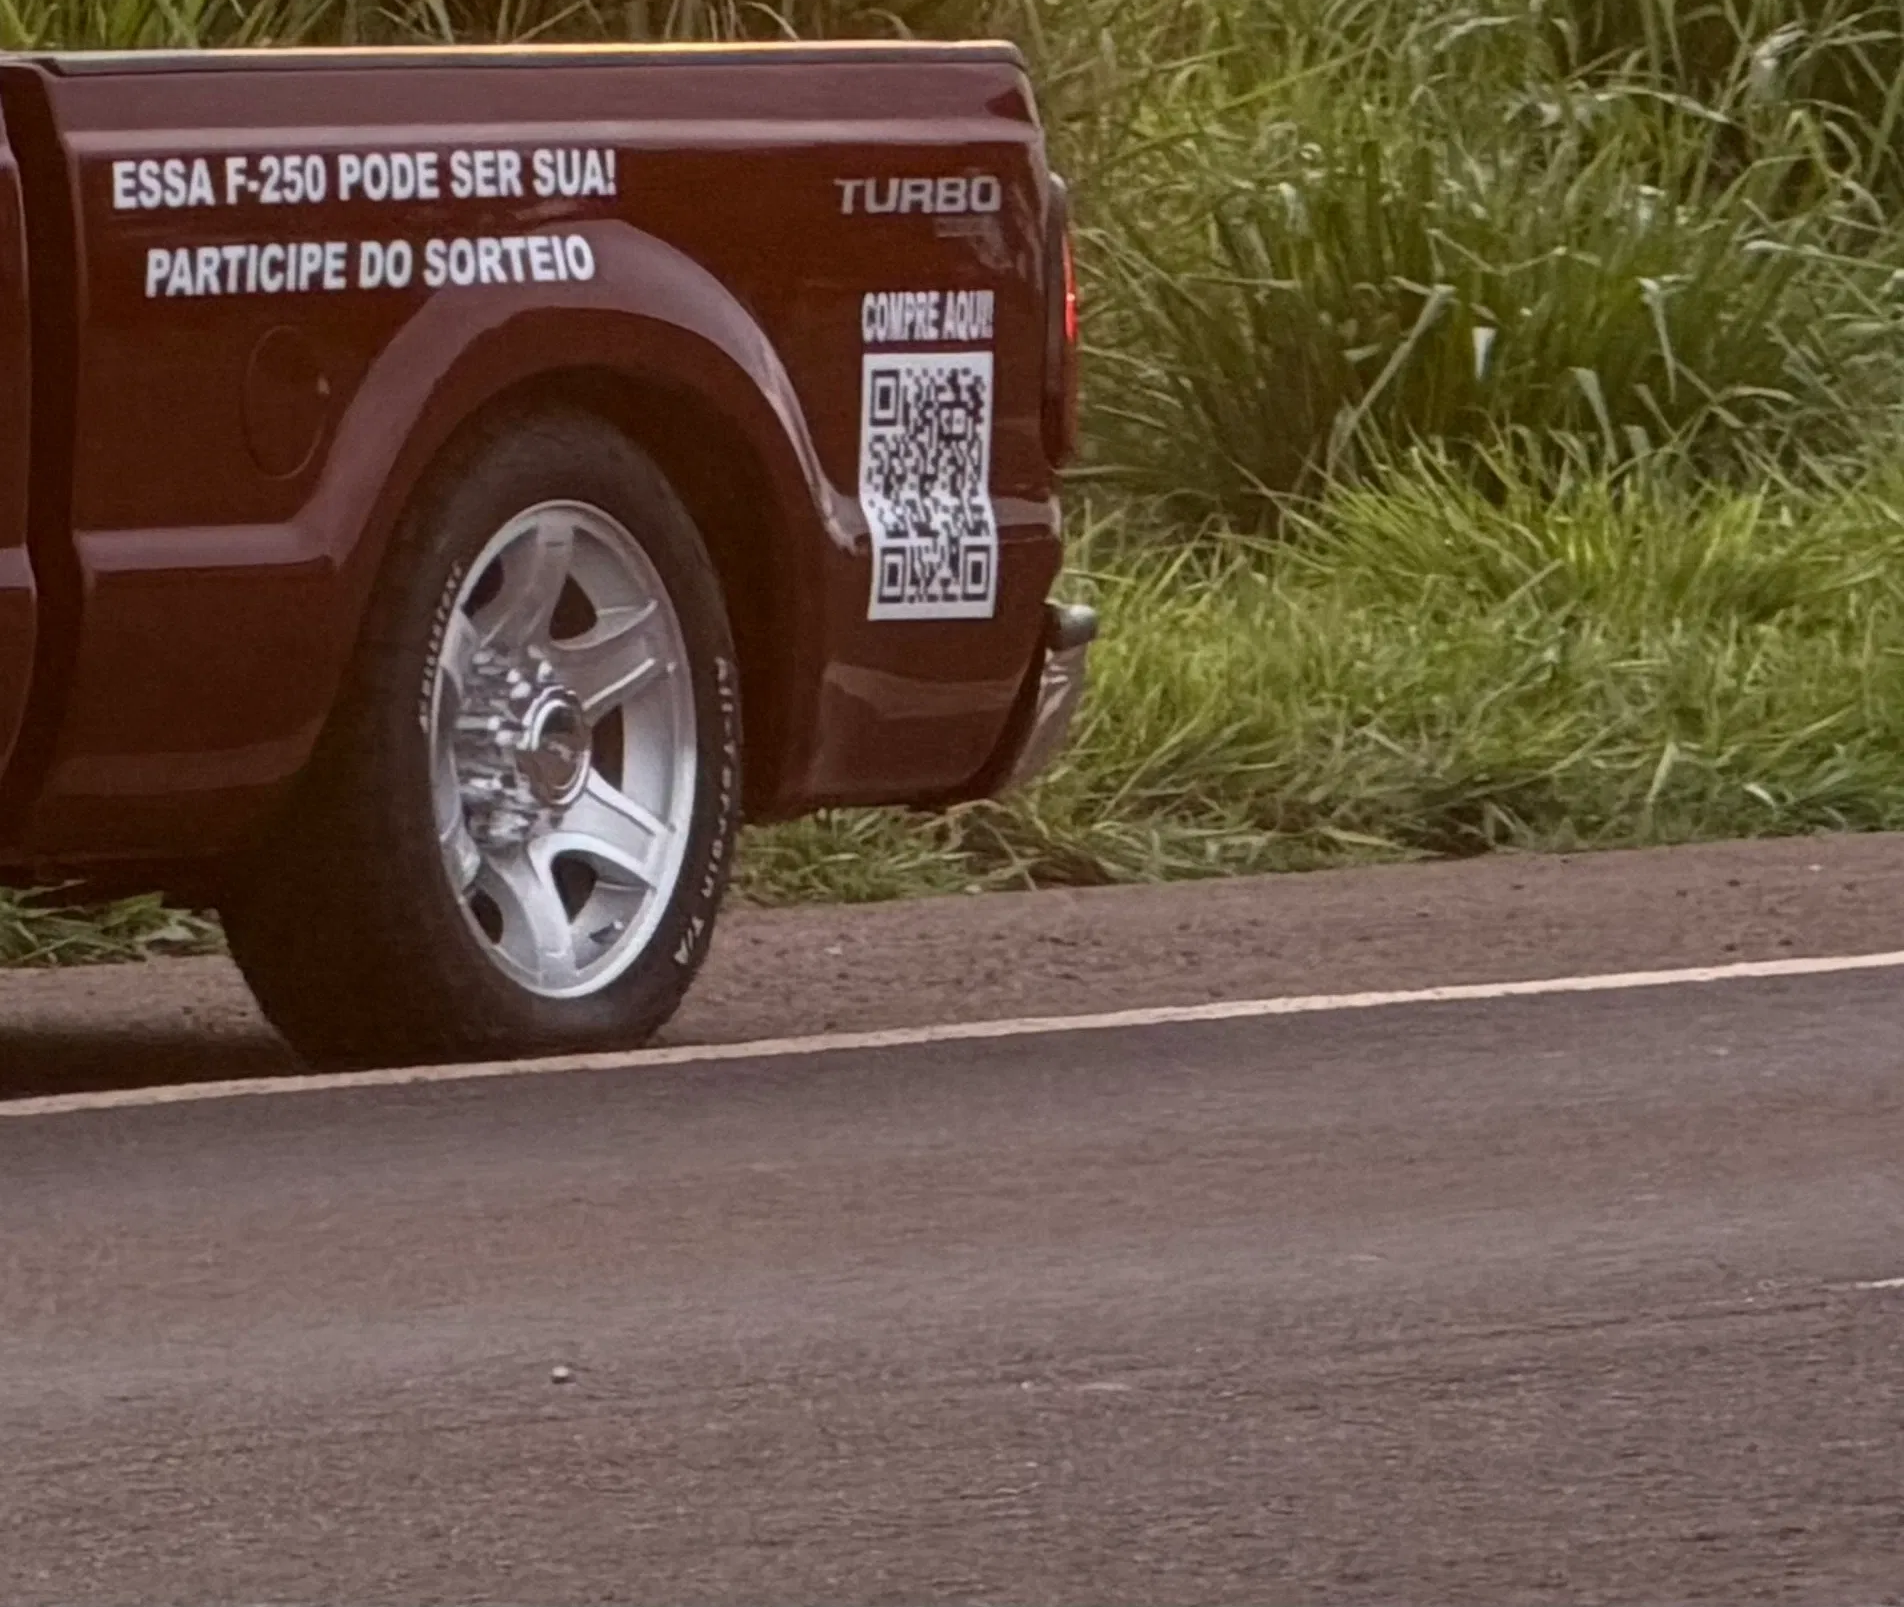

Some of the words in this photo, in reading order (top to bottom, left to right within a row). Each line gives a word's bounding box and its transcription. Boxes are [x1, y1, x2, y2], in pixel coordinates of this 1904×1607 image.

[112, 158, 217, 210] ESSA
[225, 154, 327, 205] F-250
[338, 152, 440, 202] PODE
[449, 149, 524, 199] SER
[531, 147, 617, 197] SUA!
[833, 175, 1002, 215] TURBO
[145, 241, 348, 298] PARTICIPE
[358, 239, 413, 290] DO
[422, 233, 596, 288] SORTEIO
[862, 291, 941, 343] COMPRE
